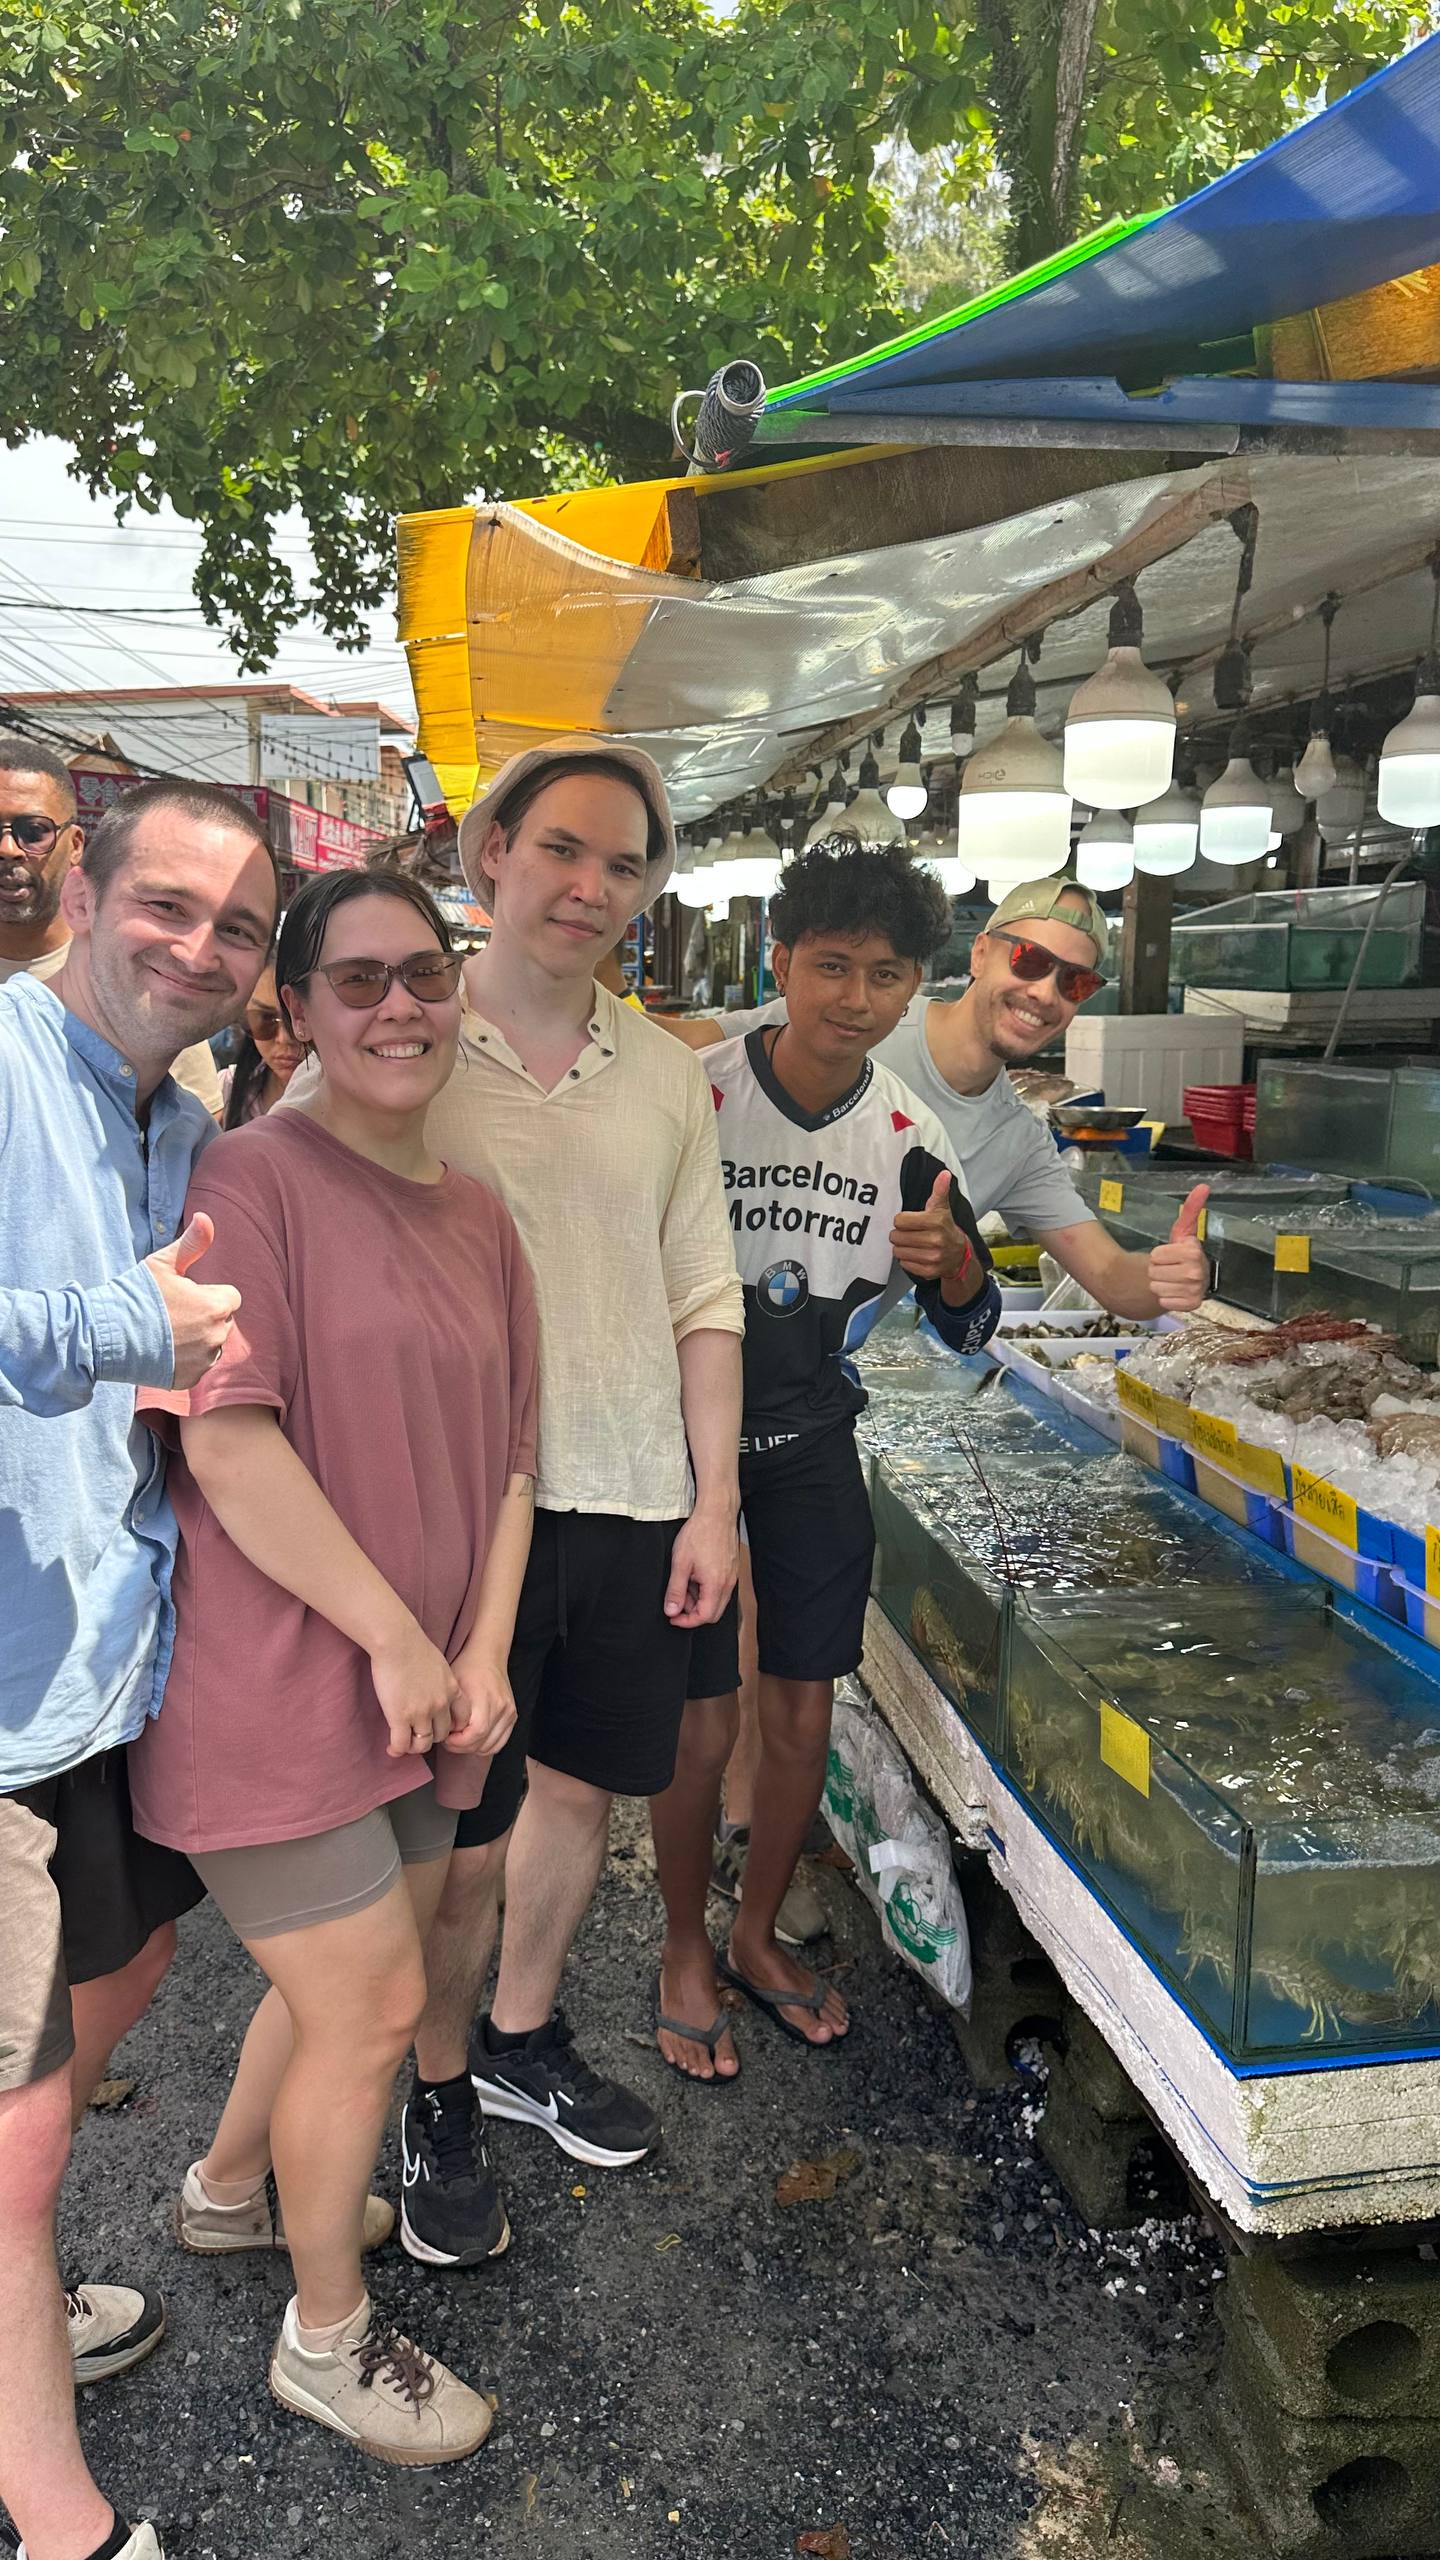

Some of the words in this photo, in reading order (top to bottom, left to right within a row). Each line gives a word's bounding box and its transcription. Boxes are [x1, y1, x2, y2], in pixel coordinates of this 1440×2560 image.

[832, 1073, 870, 1118] Barcelona
[721, 1160, 879, 1206] Barcelona
[764, 1261, 807, 1281] BMW
